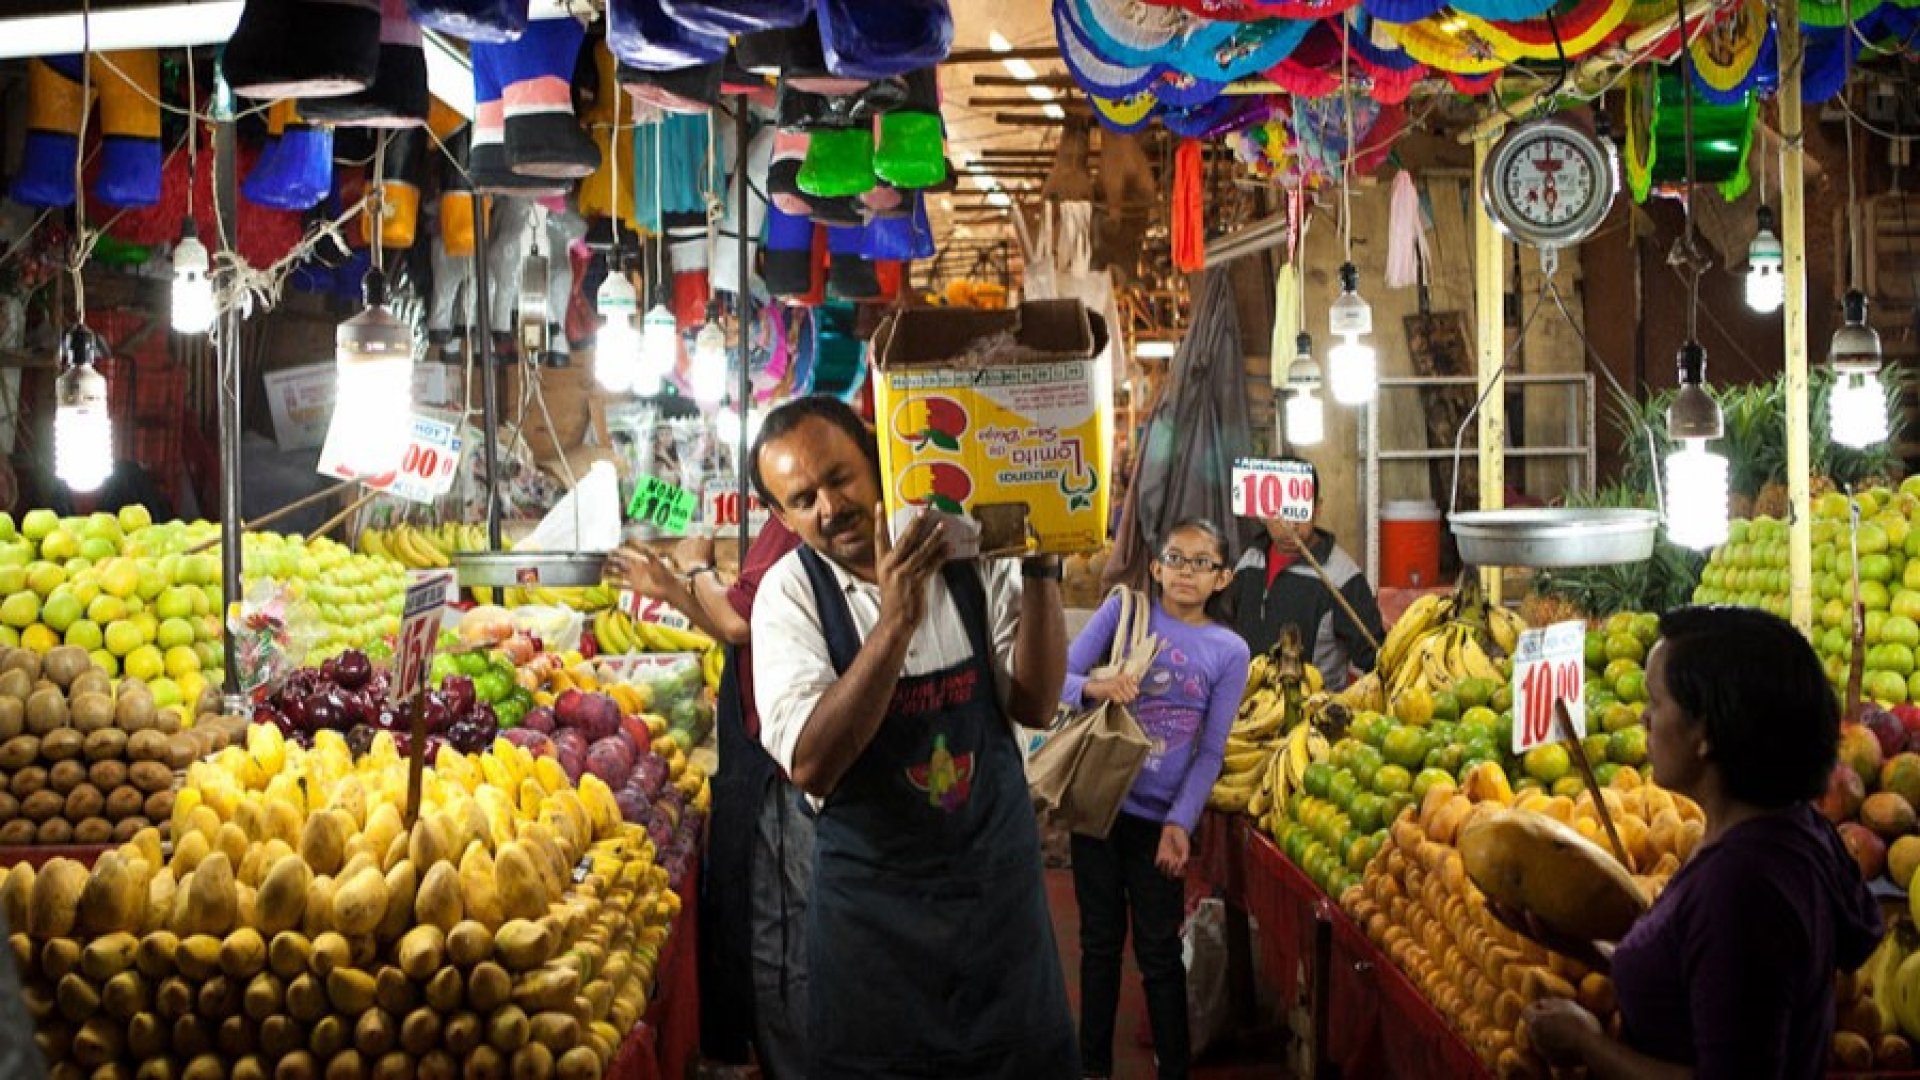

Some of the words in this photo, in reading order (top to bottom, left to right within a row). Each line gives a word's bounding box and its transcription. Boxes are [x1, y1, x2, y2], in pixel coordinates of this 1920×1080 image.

[1012, 439, 1081, 475] Lomita
[1241, 473, 1283, 518] 10
[1288, 477, 1313, 501] 00
[1283, 506, 1308, 519] KILO
[1521, 659, 1552, 748] 10
